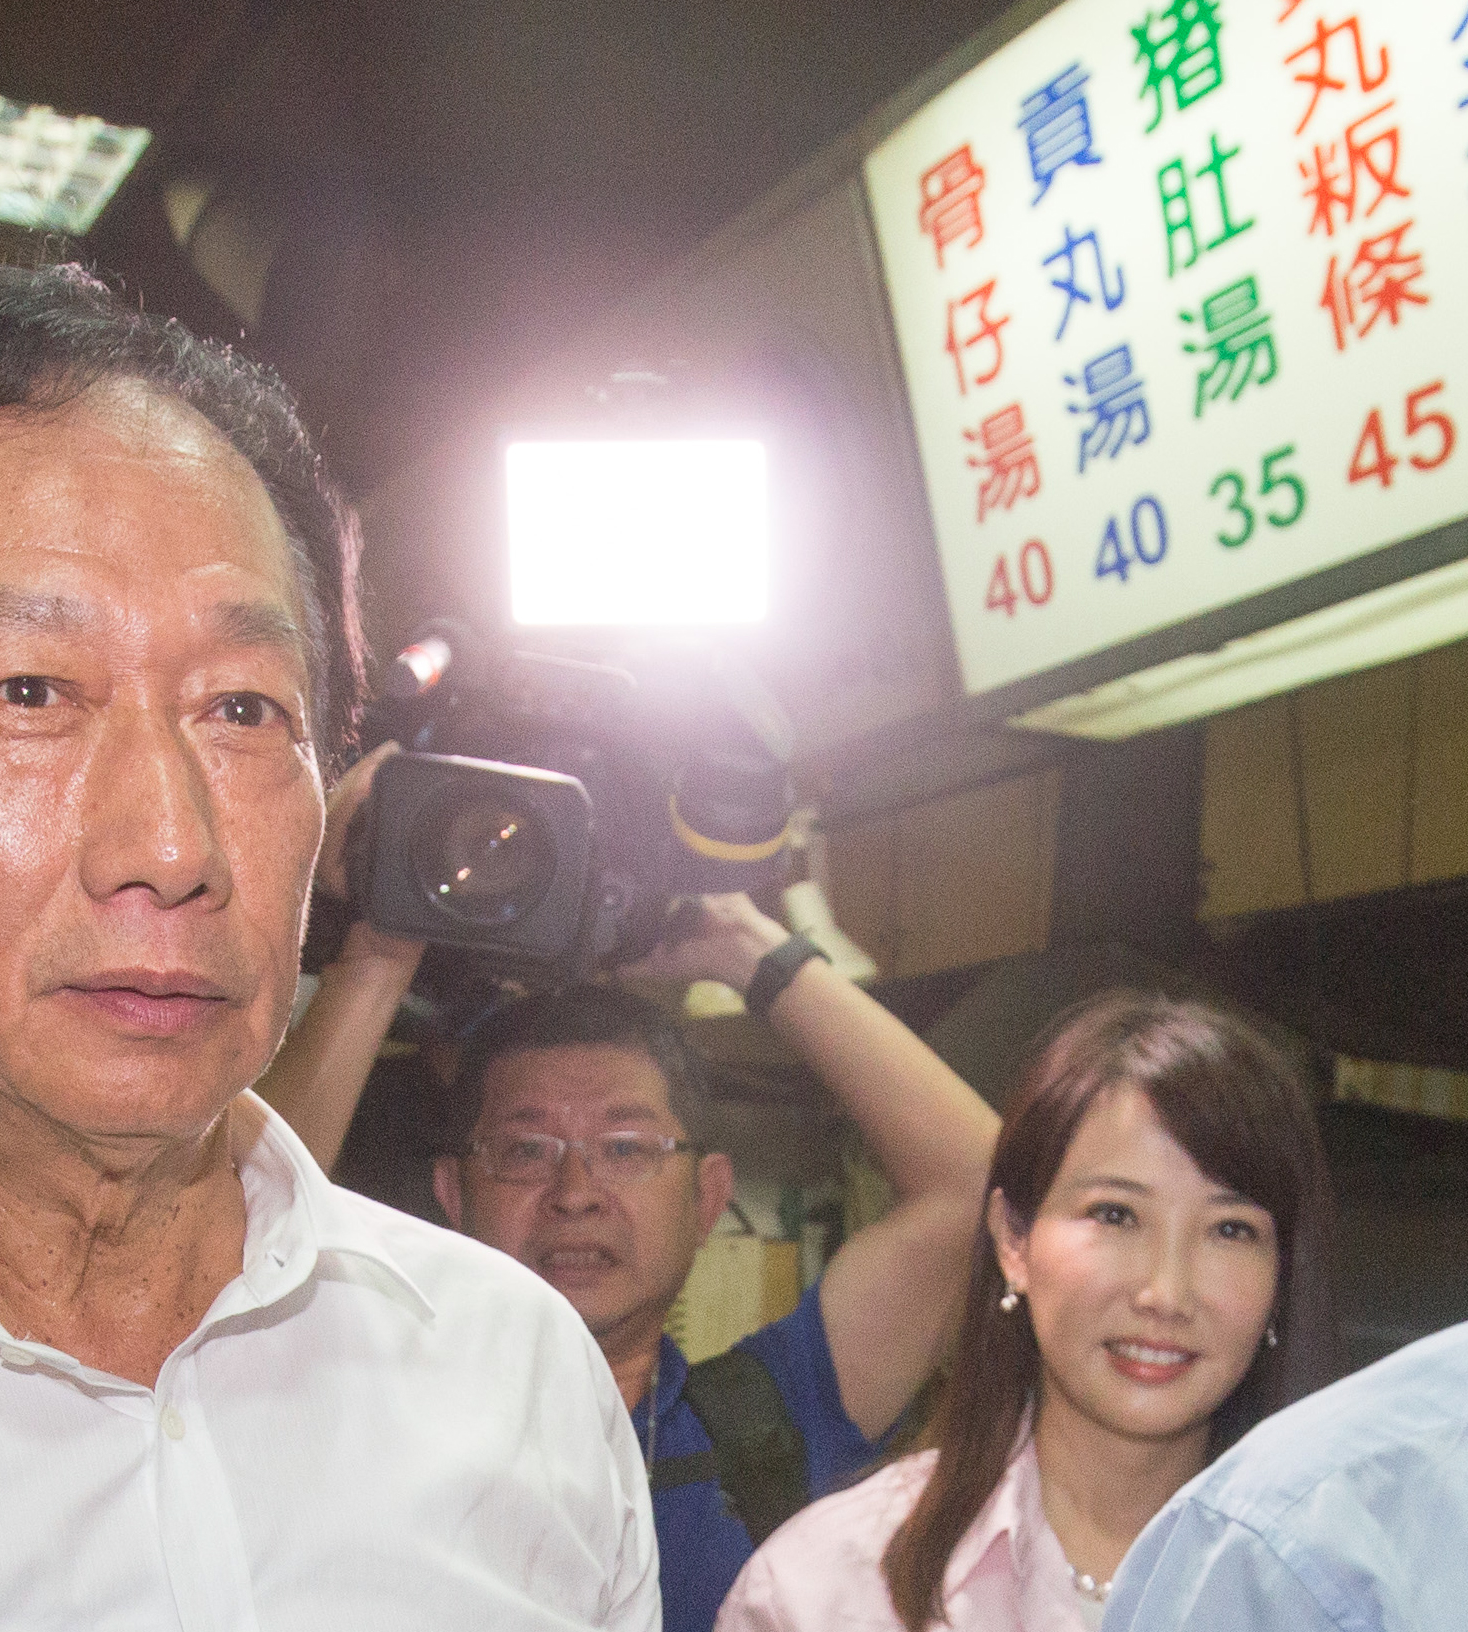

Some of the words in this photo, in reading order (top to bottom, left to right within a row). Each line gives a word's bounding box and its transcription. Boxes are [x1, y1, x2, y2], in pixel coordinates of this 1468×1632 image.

[1276, 0, 1431, 352] 丸粄條
[1017, 63, 1151, 475] 貢丸湯
[918, 142, 1042, 525] 骨仔湯
[1345, 379, 1459, 490] 45
[1094, 494, 1170, 585] 40
[1209, 445, 1308, 550] 35
[984, 538, 1055, 619] 40
